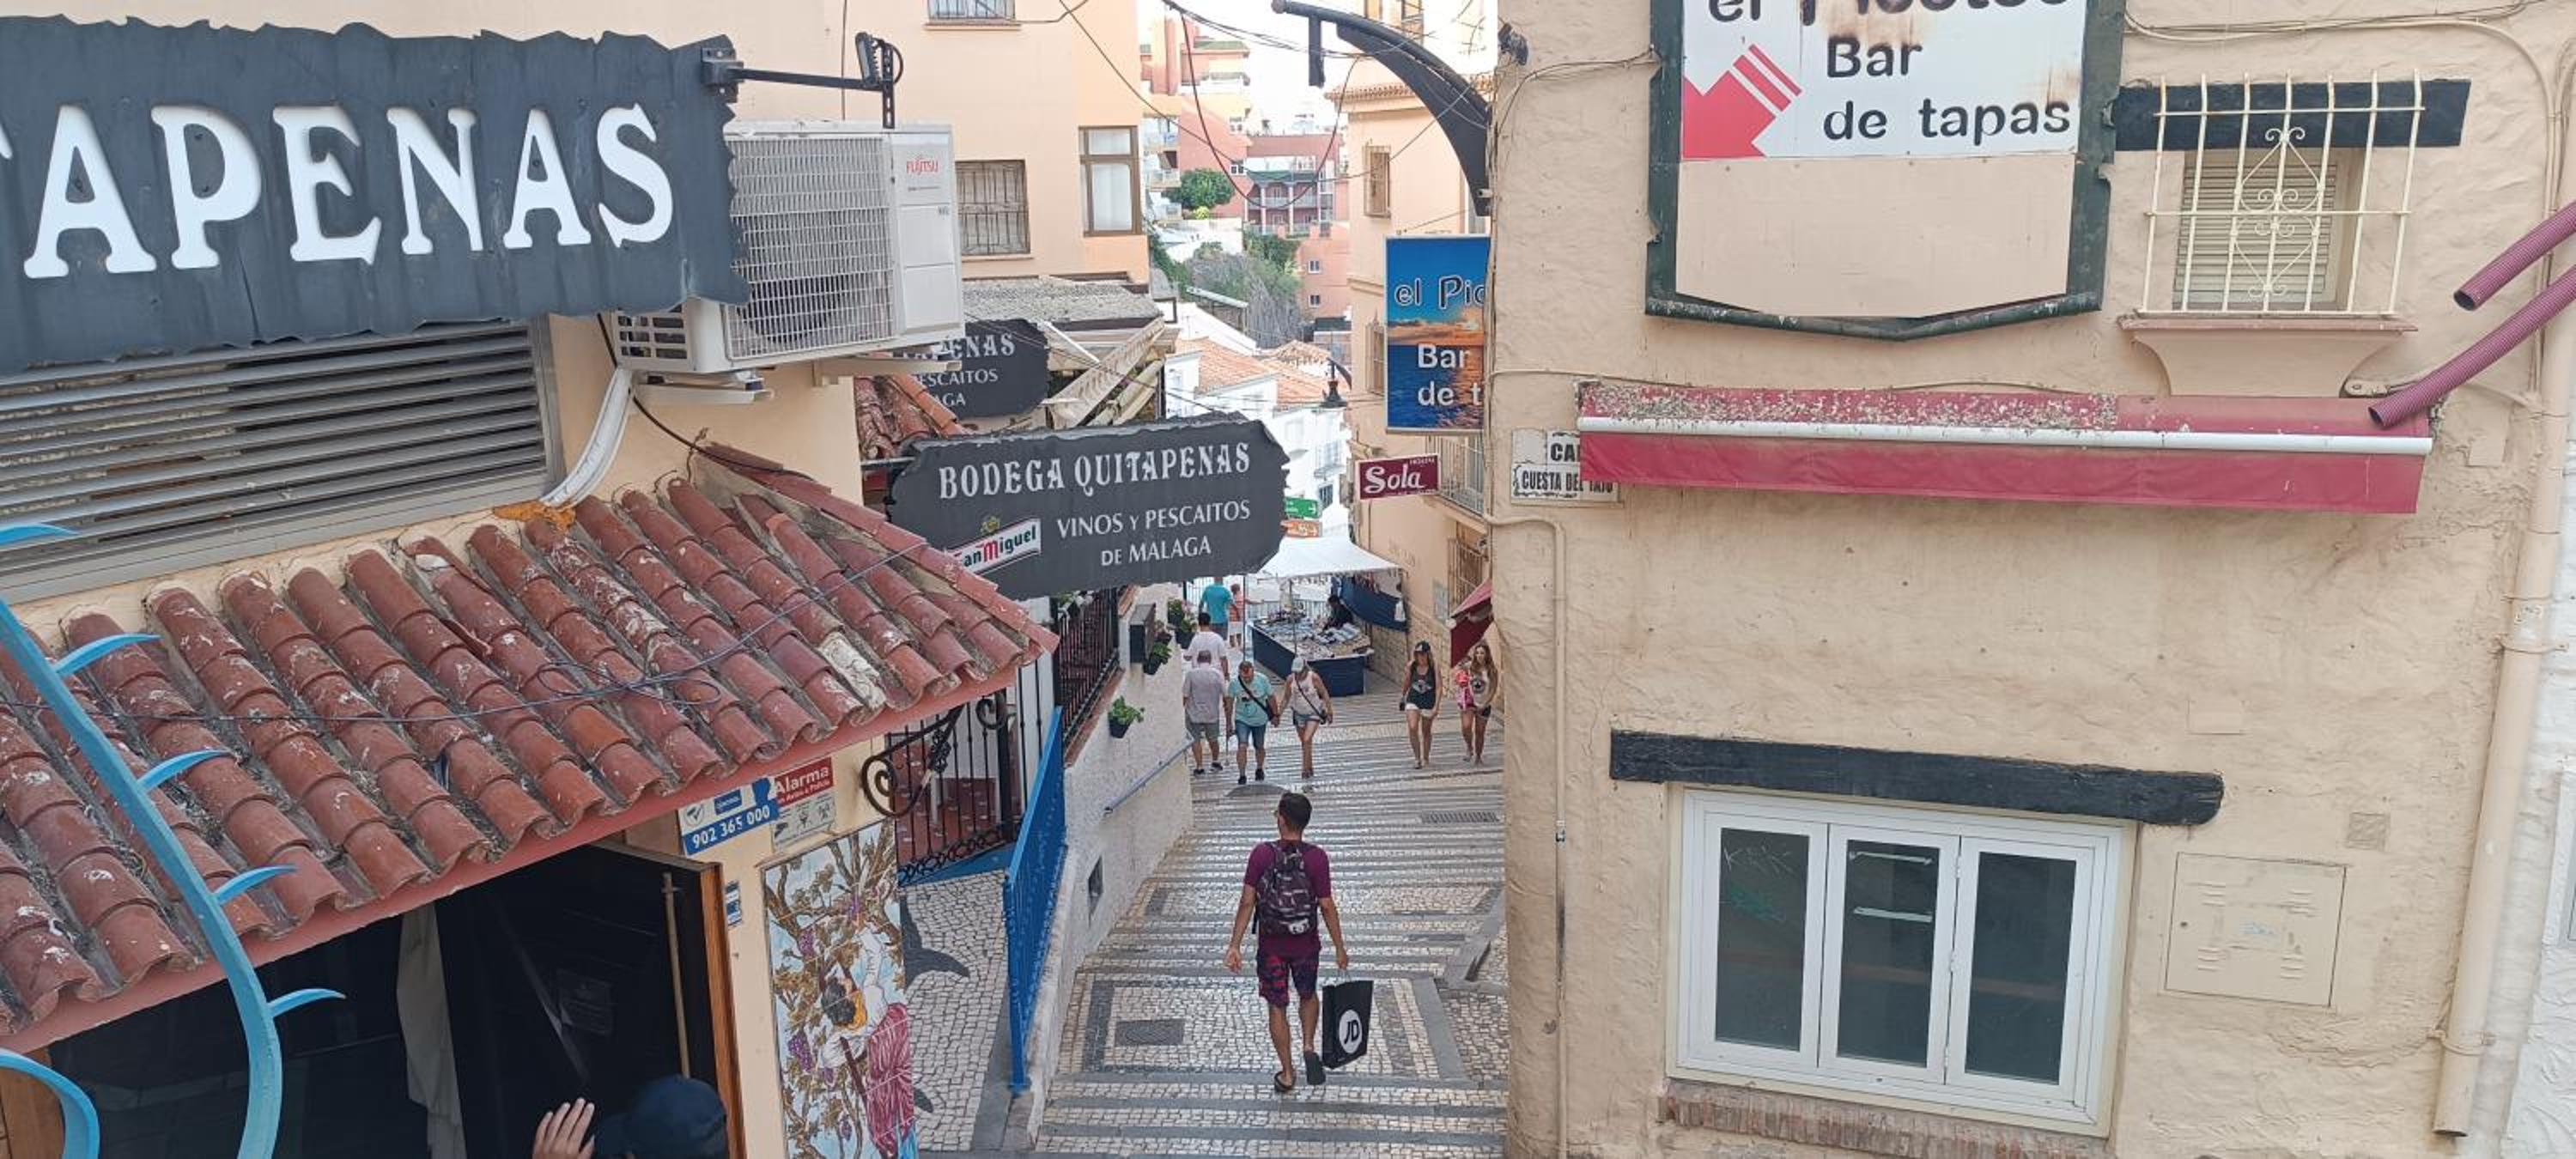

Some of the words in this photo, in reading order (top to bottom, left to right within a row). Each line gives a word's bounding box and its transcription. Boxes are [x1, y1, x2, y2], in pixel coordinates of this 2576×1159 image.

[1826, 35, 1923, 78] Bar
[1823, 100, 1888, 140] de
[1917, 98, 2071, 146] tapas
[0, 103, 673, 279] APENAS
[1394, 277, 1421, 306] el
[945, 332, 1016, 360] ENAS
[1418, 343, 1471, 368] Bar
[920, 368, 999, 386] ESCAITOS
[1418, 381, 1454, 406] de
[939, 458, 1066, 499] BODEGA
[1074, 442, 1250, 496] QUITAPENAS
[1364, 464, 1425, 494] Sola
[1522, 470, 1561, 491] CUESTA
[1566, 472, 1584, 492] DEL
[1057, 513, 1123, 539] VINOS
[1145, 500, 1251, 530] PESCAITOS
[1101, 549, 1122, 566] DE
[1129, 536, 1212, 563] MALAGA
[775, 767, 829, 794] Alarma
[692, 827, 717, 848] 902
[720, 816, 743, 834] 365
[746, 804, 770, 825] 000
[1344, 1019, 1360, 1044] JD
